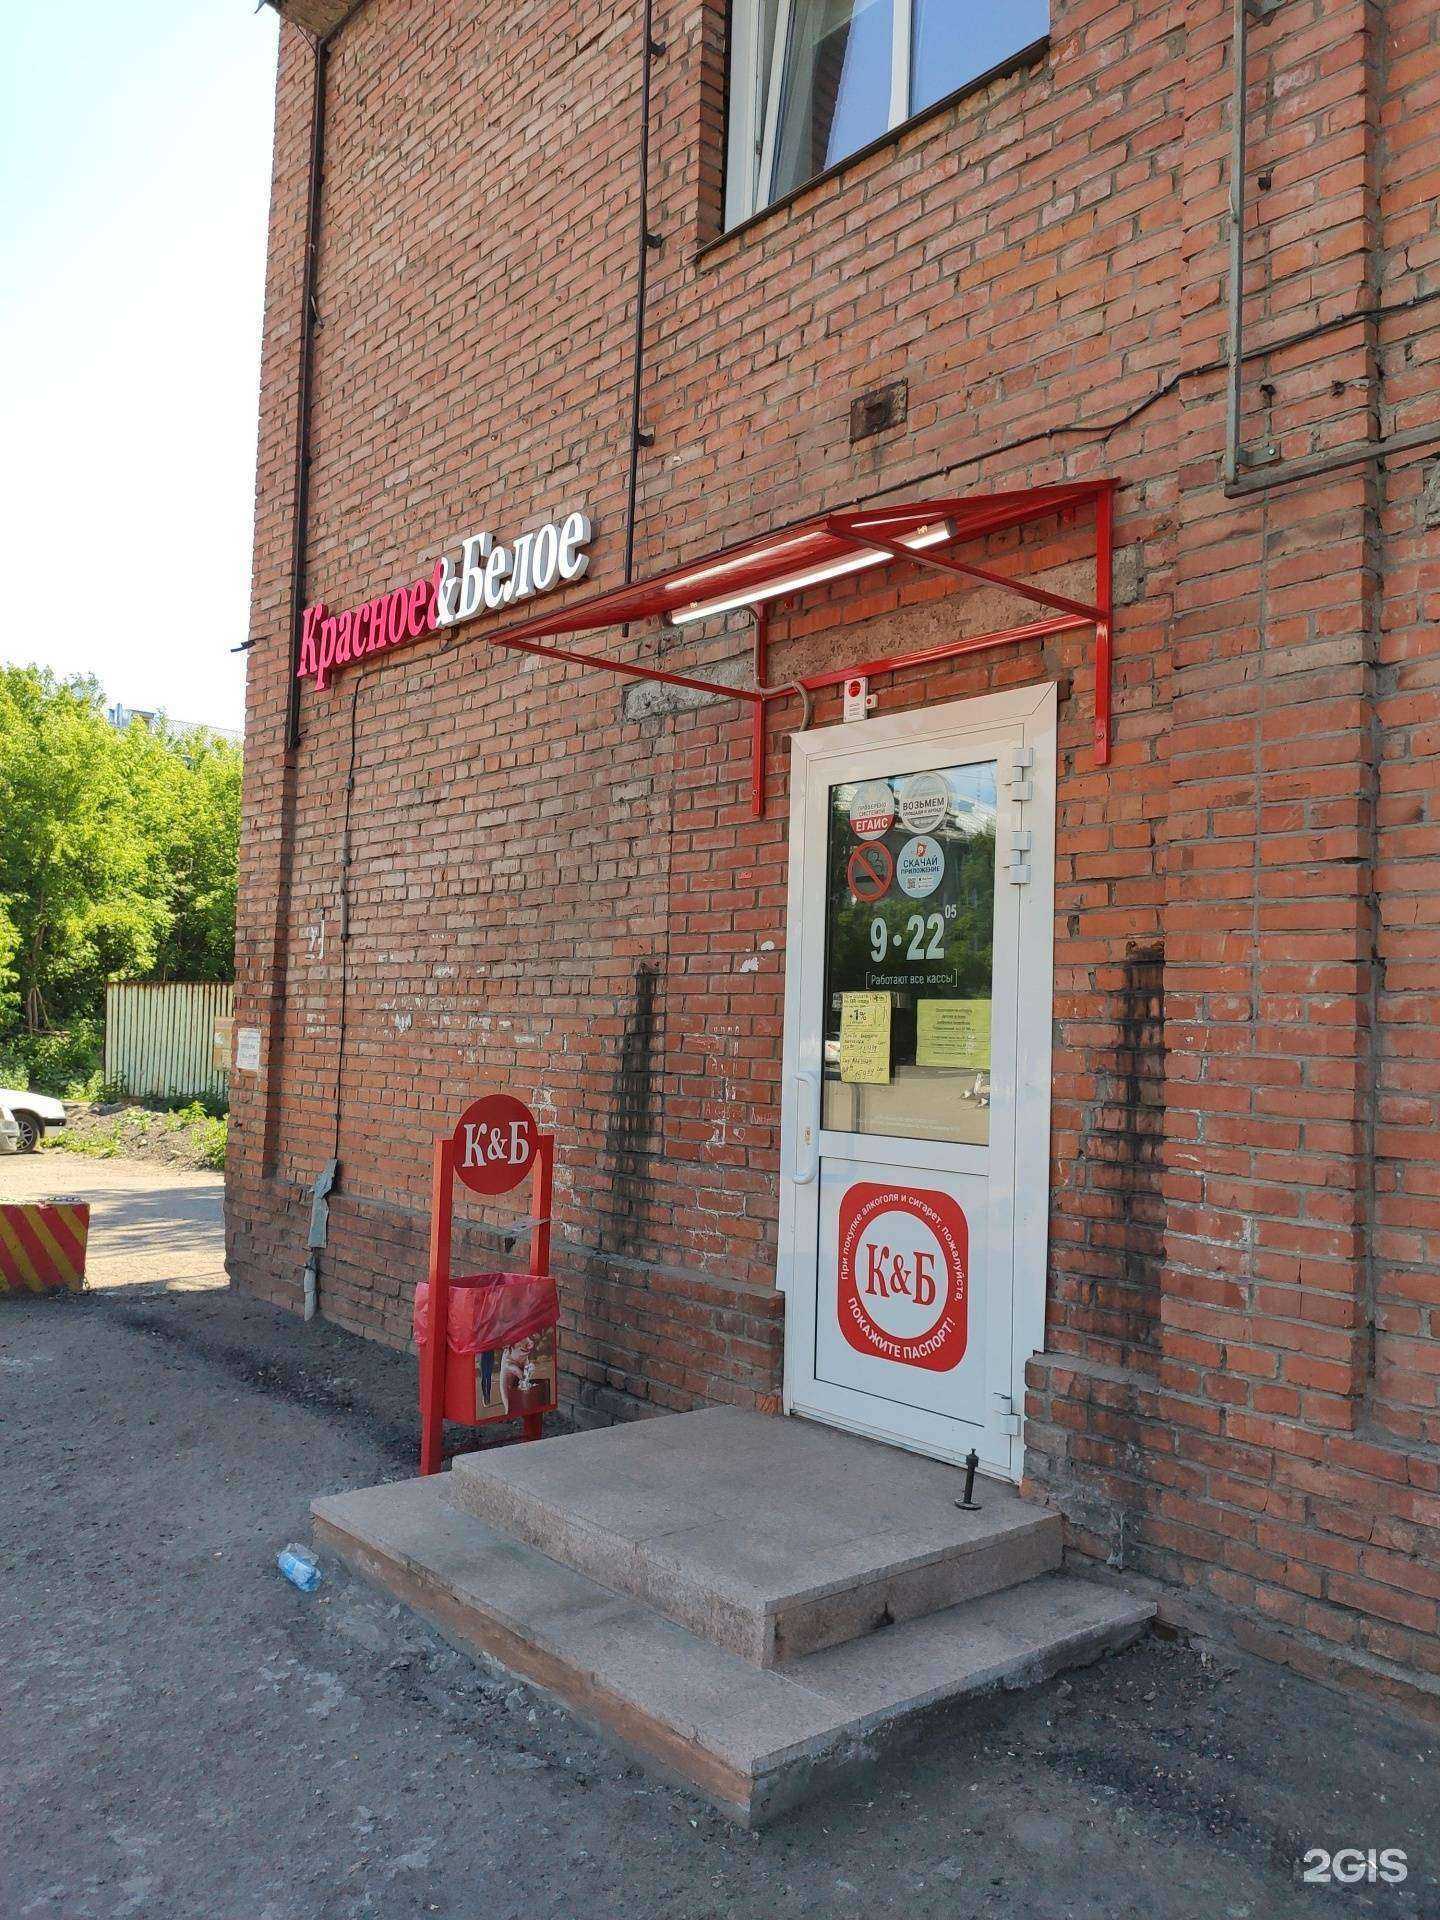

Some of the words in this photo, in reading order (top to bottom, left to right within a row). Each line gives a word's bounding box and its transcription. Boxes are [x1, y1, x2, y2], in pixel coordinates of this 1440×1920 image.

[902, 796, 945, 811] ВОЗЬМЕМ
[856, 817, 888, 832] ЕГАИС
[900, 865, 941, 875] ПРИЛОЖЕНИЕ
[903, 855, 938, 868] СКАЧАЙ
[944, 904, 957, 919] 05
[871, 974, 909, 986] Работают
[910, 974, 924, 985] все
[926, 973, 953, 985] кассы
[462, 1121, 530, 1168] К&Б
[862, 1193, 899, 1216] алкоголя
[908, 1196, 943, 1228] сигарет,
[843, 1212, 863, 1257] покупке
[841, 1257, 849, 1280] При
[865, 1243, 936, 1306] К&Б
[941, 1226, 965, 1302] пожалуйста,
[848, 1297, 901, 1358] ПОКАЖИТЕ
[903, 1316, 956, 1359] ПАСПОРТ!
